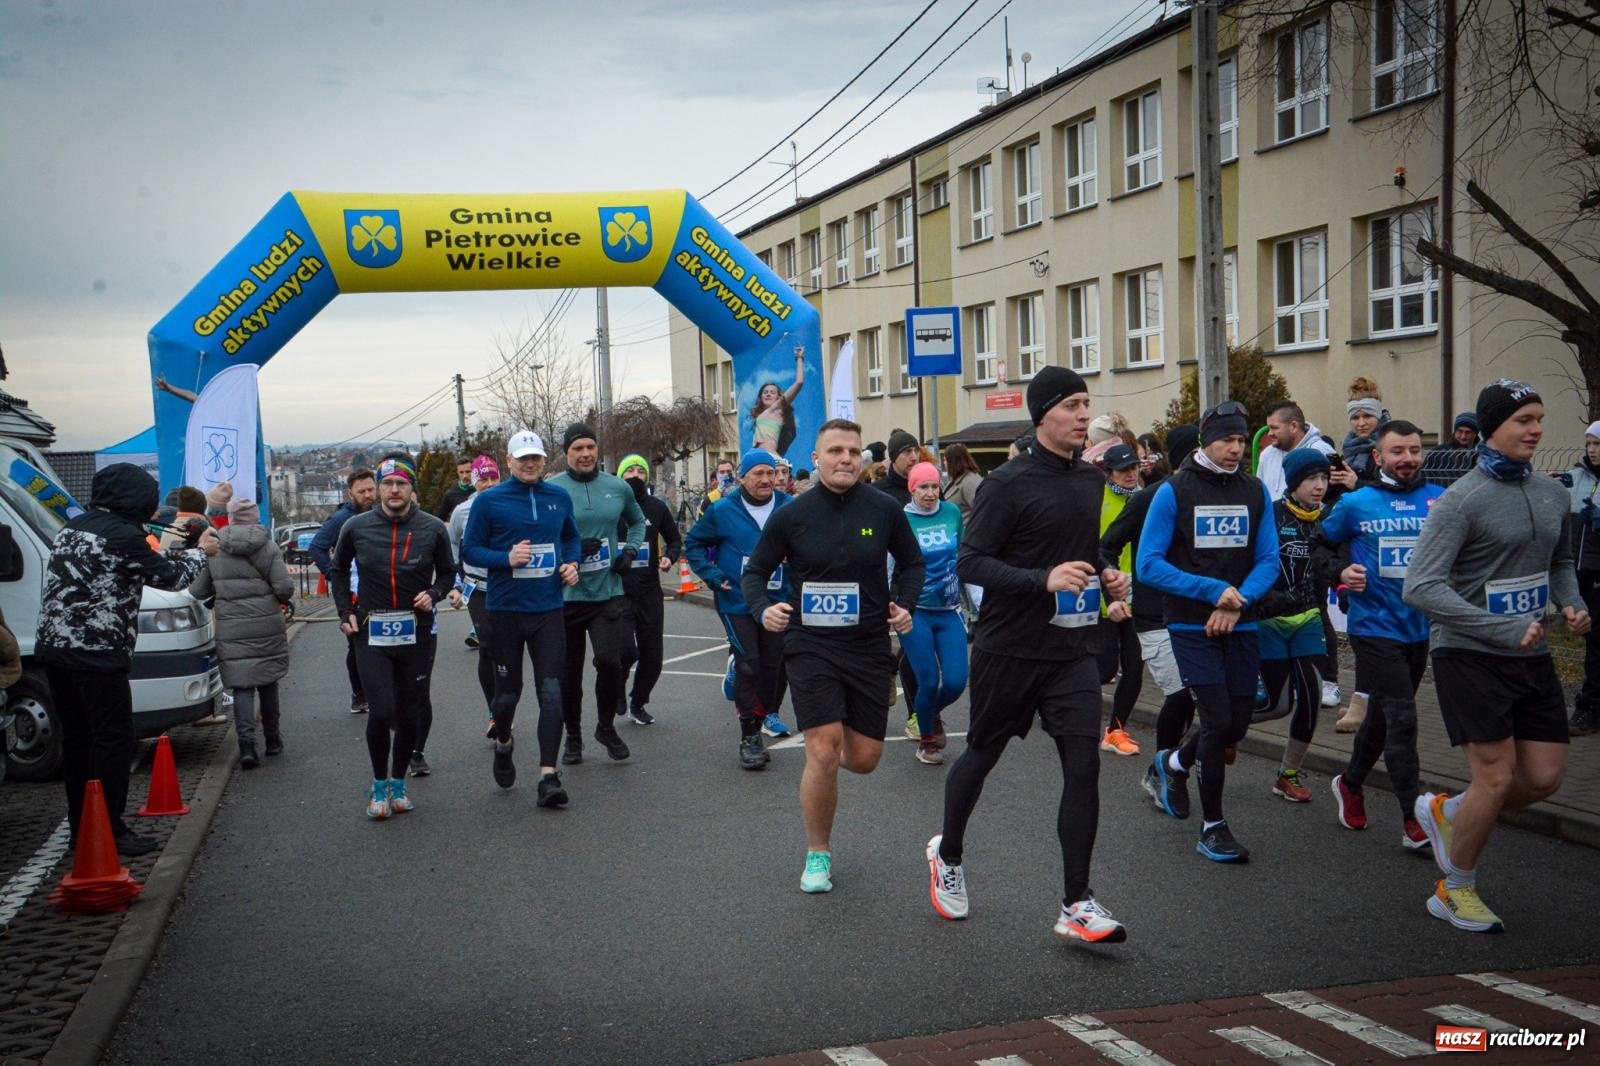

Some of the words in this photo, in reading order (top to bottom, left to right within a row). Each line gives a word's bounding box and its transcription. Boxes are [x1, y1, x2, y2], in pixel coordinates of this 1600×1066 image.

[450, 208, 552, 224] Gmina
[425, 226, 581, 248] Pietrowice
[446, 250, 561, 271] Wielkie
[193, 278, 257, 337] Gmina
[250, 229, 304, 281] ludzi
[689, 225, 746, 282] Gmina
[744, 273, 793, 321] ludzi
[221, 254, 324, 355] aktywnych
[674, 250, 772, 338] aktywnych
[1206, 517, 1241, 535] 164
[526, 553, 545, 568] 27
[810, 594, 848, 613] 205
[1076, 591, 1086, 612] 6
[1501, 588, 1540, 614] 181
[382, 621, 402, 636] 59
